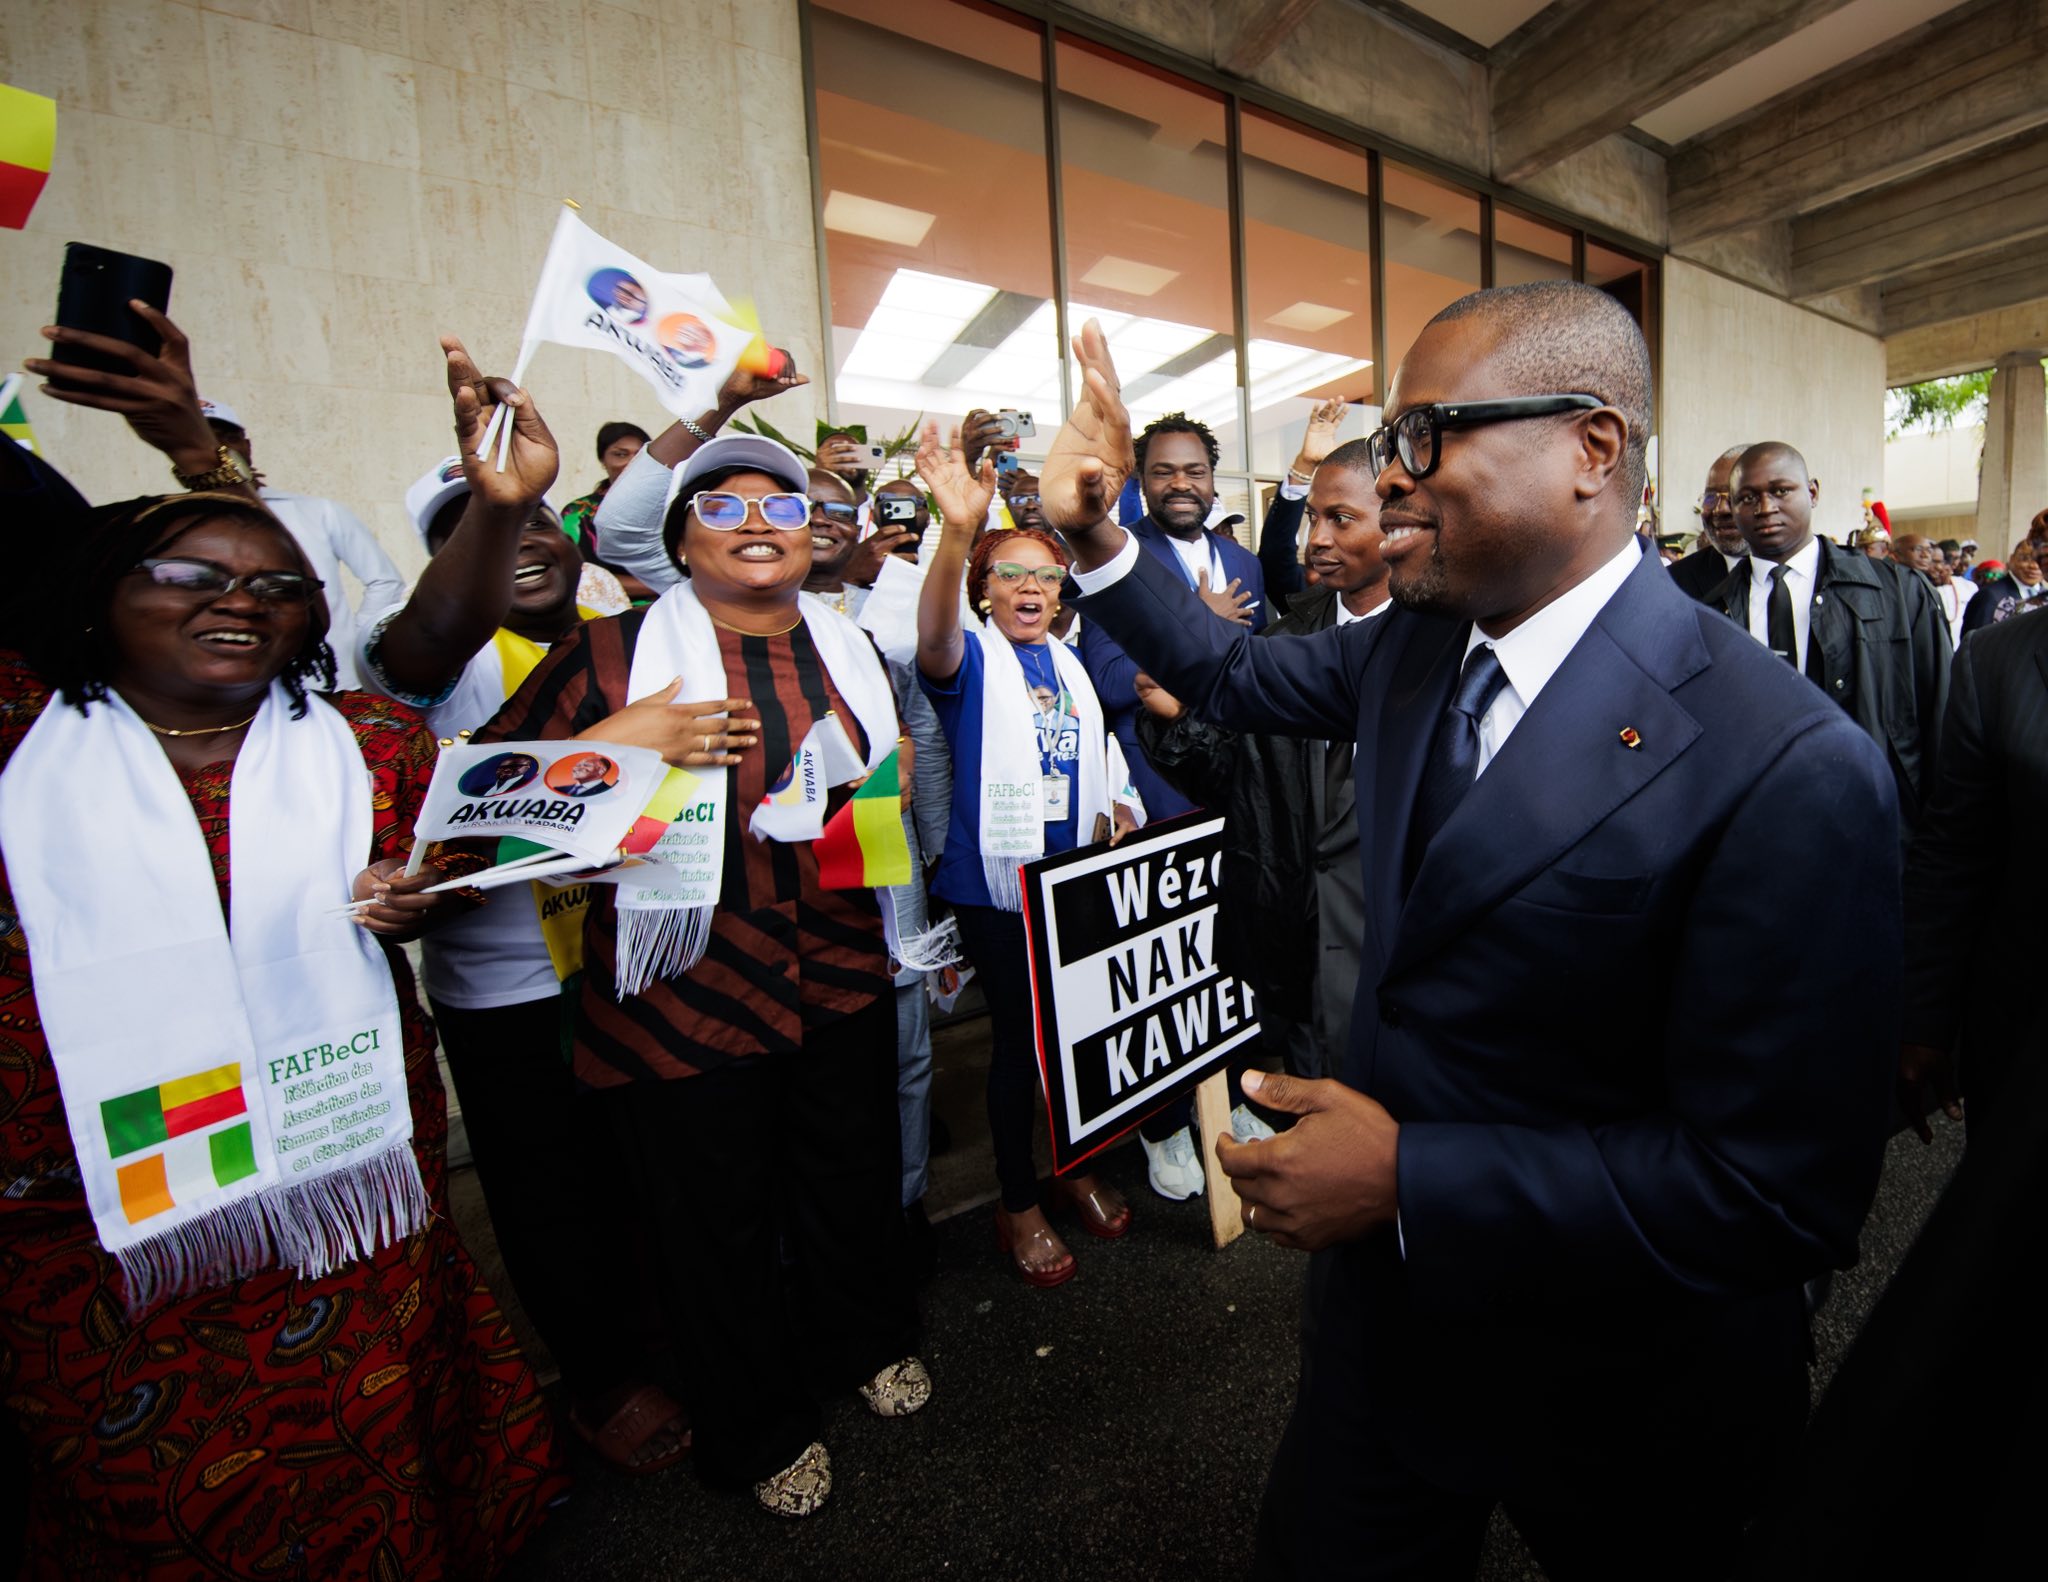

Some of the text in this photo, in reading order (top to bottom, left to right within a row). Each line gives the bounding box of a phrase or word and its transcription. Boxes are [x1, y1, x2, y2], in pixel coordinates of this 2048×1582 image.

[803, 749, 816, 803] AKWABA
[987, 782, 1036, 798] FAFBeCI
[447, 799, 586, 826] AKWABA
[524, 819, 576, 833] WADAGNI
[1106, 918, 1215, 1014] NAK
[267, 1028, 381, 1085] FAFBeCI
[282, 1081, 382, 1129] Associations des
[283, 1061, 373, 1104] Fédération des
[276, 1100, 391, 1154] Femmes Béninoises
[292, 1155, 312, 1172] en
